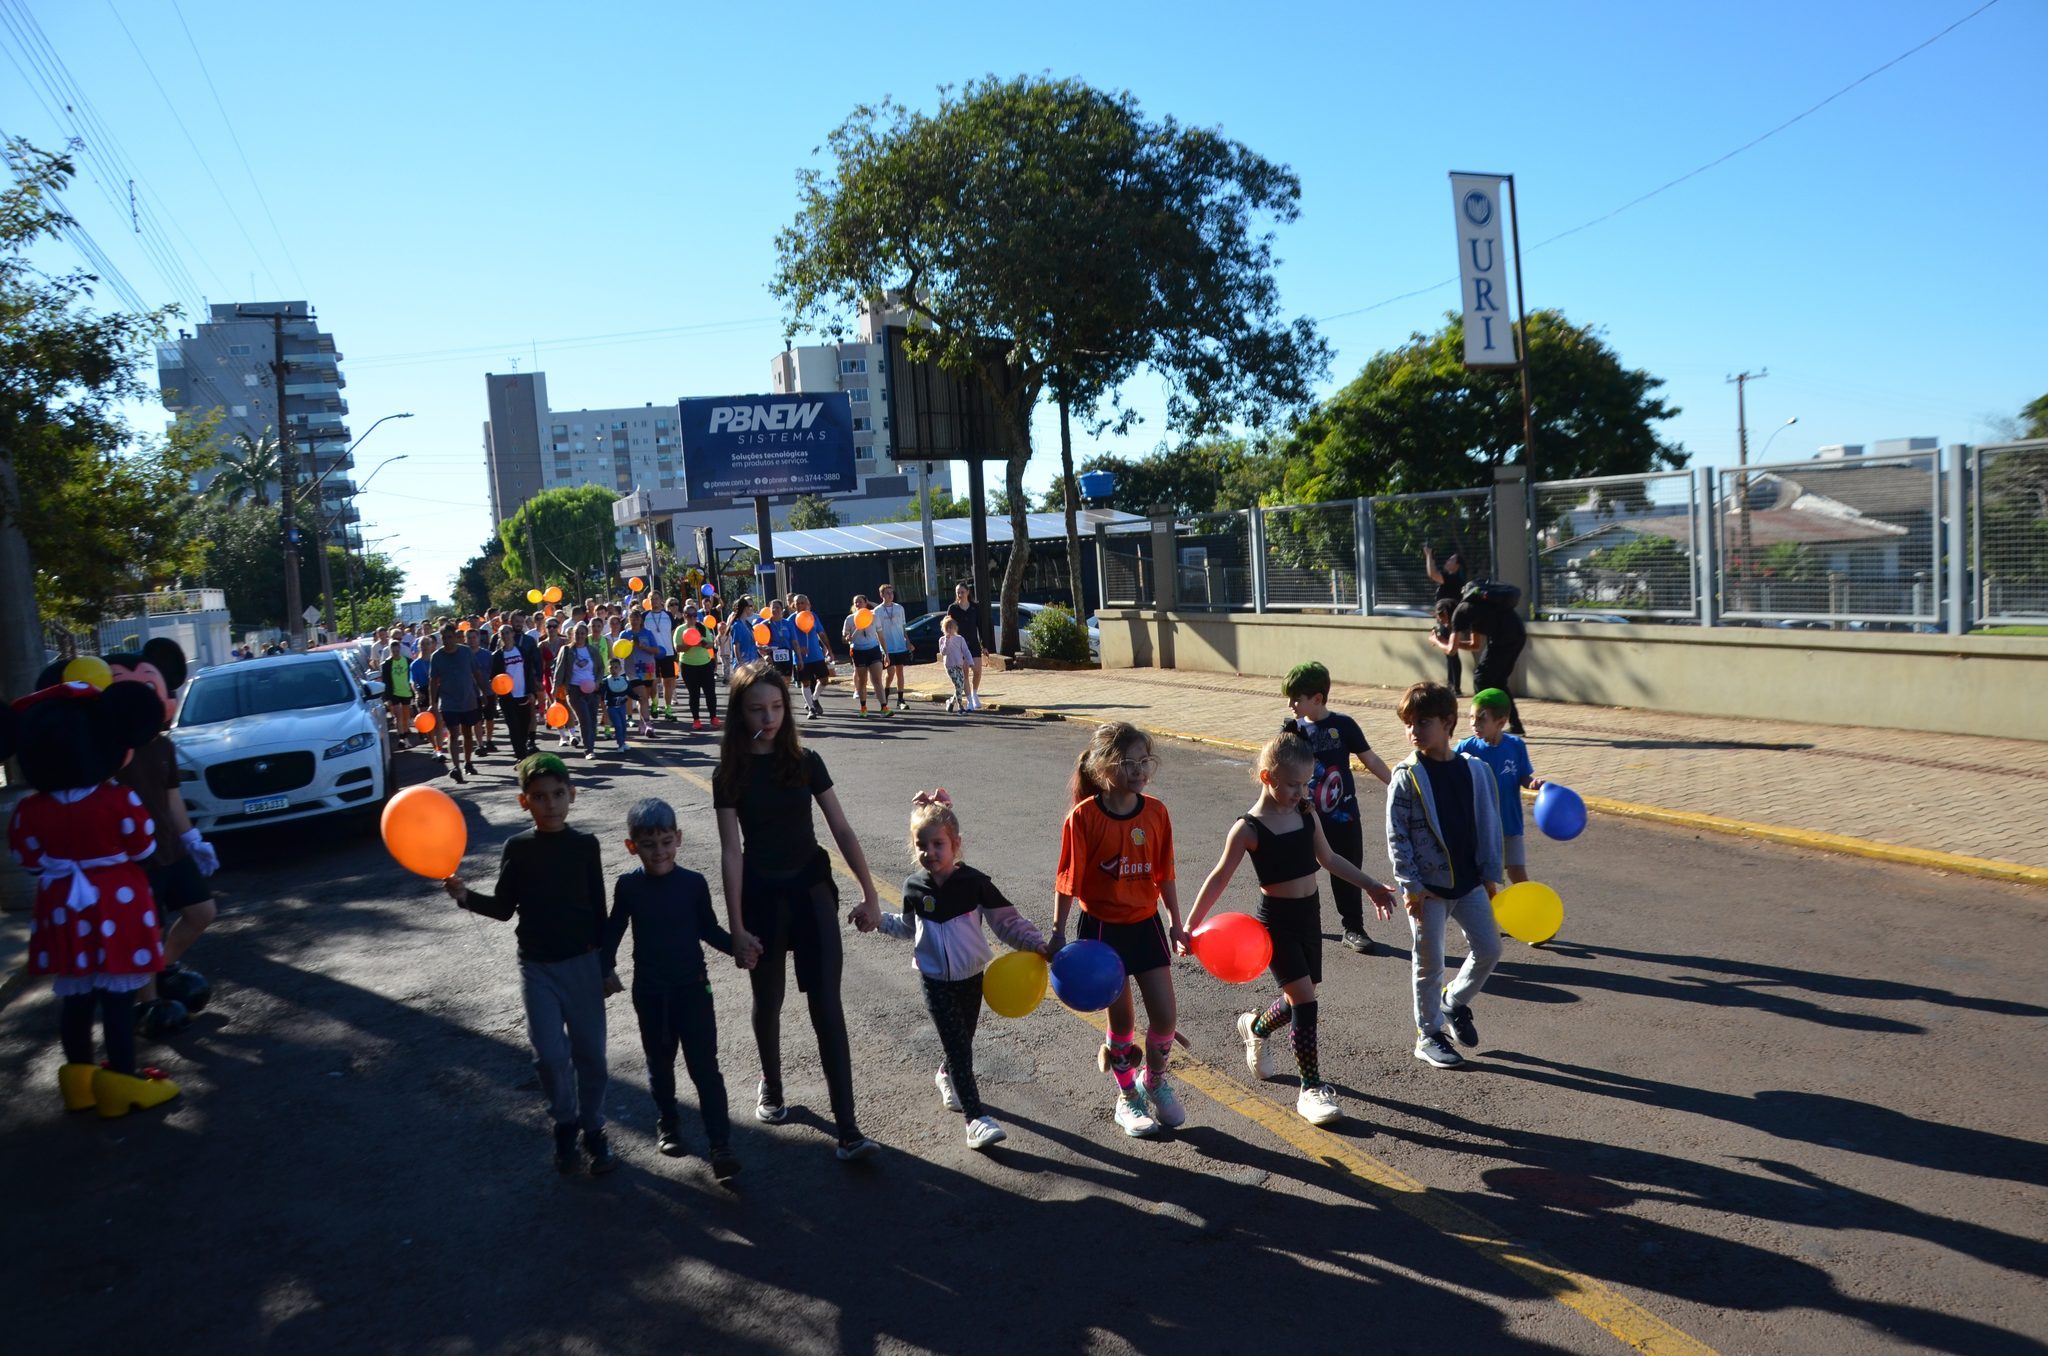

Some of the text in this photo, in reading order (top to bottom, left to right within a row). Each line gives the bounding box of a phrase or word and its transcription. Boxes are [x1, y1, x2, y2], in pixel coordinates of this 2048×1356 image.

[1468, 237, 1499, 350] URI
[709, 402, 824, 434] PBNEW
[738, 431, 827, 444] SISTEMAS
[764, 449, 808, 458] tecnológicas
[744, 459, 775, 468] produtos
[711, 479, 751, 488] pbnew.com.br
[768, 476, 788, 485] pbnew
